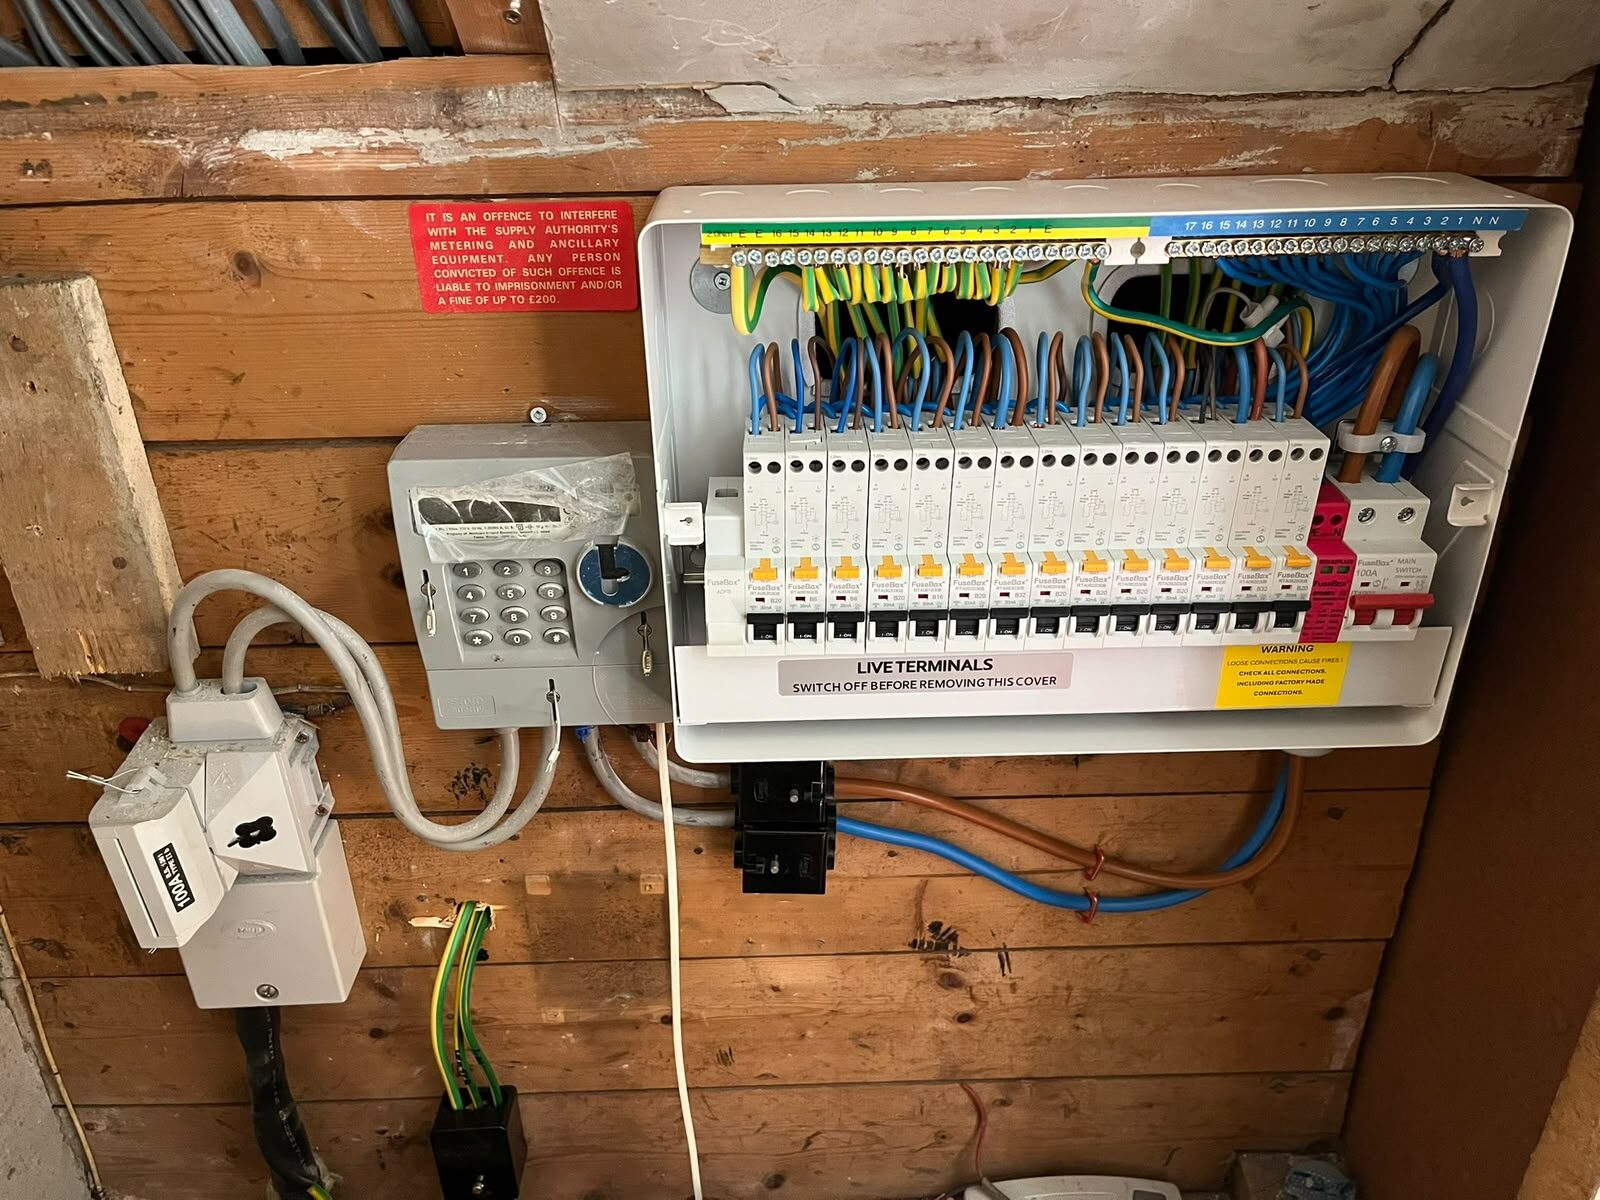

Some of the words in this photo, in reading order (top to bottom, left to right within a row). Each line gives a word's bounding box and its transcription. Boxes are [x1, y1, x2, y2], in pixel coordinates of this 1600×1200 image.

[426, 213, 435, 222] IT
[443, 212, 453, 222] IS
[460, 213, 476, 221] AN
[483, 211, 532, 221] OFFENCE
[539, 211, 554, 221] TO
[561, 211, 617, 220] INTERFERE
[1185, 222, 1197, 230] 17
[1201, 221, 1213, 230] 16
[1219, 221, 1231, 230] 15
[1236, 221, 1247, 229] 14
[1253, 220, 1264, 229] 13
[1270, 220, 1282, 228] 12
[1287, 219, 1298, 228] 11
[1304, 219, 1316, 227] 10
[1324, 219, 1331, 227] 9
[1340, 218, 1347, 227] 8
[1357, 218, 1365, 226] 7
[1372, 217, 1380, 226] 6
[1390, 217, 1398, 225] 5
[1406, 217, 1415, 225] 4
[1424, 217, 1432, 225] 3
[1441, 217, 1449, 225] 2
[1458, 217, 1463, 225] 1
[1472, 217, 1483, 225] N
[1489, 216, 1499, 224] N
[428, 227, 456, 236] WITH
[465, 227, 487, 236] THE
[496, 226, 536, 235] SUPPLY
[545, 225, 618, 234] AUTHORITY'S
[739, 230, 746, 238] E
[756, 229, 763, 238] E
[773, 229, 782, 237] 16
[789, 229, 799, 237] 15
[805, 229, 815, 237] 14
[821, 229, 832, 237] 13
[838, 229, 848, 237] 12
[873, 228, 882, 236] 10
[892, 227, 897, 236] 9
[911, 227, 917, 235] 8
[927, 227, 933, 235] 7
[960, 226, 966, 234] 5
[977, 226, 983, 234] 4
[993, 226, 1000, 234] 3
[1010, 226, 1017, 234] 2
[1044, 225, 1052, 233] E
[430, 241, 493, 250] METERING
[509, 240, 534, 249] AND
[550, 239, 619, 248] ANCILLARY
[432, 255, 509, 264] EQUIPMENT.
[528, 254, 552, 263] ANY
[572, 253, 621, 262] PERSON
[434, 269, 496, 278] CONVICTED
[503, 268, 516, 277] OF
[522, 268, 552, 276] SUCH
[558, 267, 606, 276] OFFENCE
[612, 267, 621, 275] IS
[436, 283, 471, 292] LIABLE
[476, 282, 490, 291] TO
[495, 281, 576, 291] IMPRISONMENT
[581, 281, 623, 289] AND/OR
[438, 296, 446, 305] A
[450, 296, 472, 305] FINE
[475, 296, 489, 305] OF
[492, 296, 506, 305] UP
[510, 295, 525, 304] TO
[529, 295, 560, 304] £200.
[1333, 528, 1342, 537] N
[463, 567, 468, 576] 1
[504, 567, 511, 575] 2
[544, 566, 551, 574] 3
[1357, 569, 1377, 577] 100A
[466, 591, 473, 599] 4
[507, 590, 514, 598] 5
[548, 589, 554, 598] 6
[470, 614, 477, 622] 7
[510, 613, 518, 621] 8
[550, 611, 557, 620] 9
[514, 636, 520, 644] 0
[1261, 645, 1314, 653] WARNING
[858, 661, 893, 674] LIVE
[895, 658, 993, 673] TERMINALS
[793, 683, 840, 693] SWITCH
[843, 682, 868, 691] OFF
[870, 680, 917, 690] BEFORE
[920, 678, 985, 689] REMOVING
[986, 677, 1014, 687] THIS
[1016, 676, 1057, 686] COVER
[168, 858, 178, 875] TYPE
[168, 872, 190, 907] 100A
